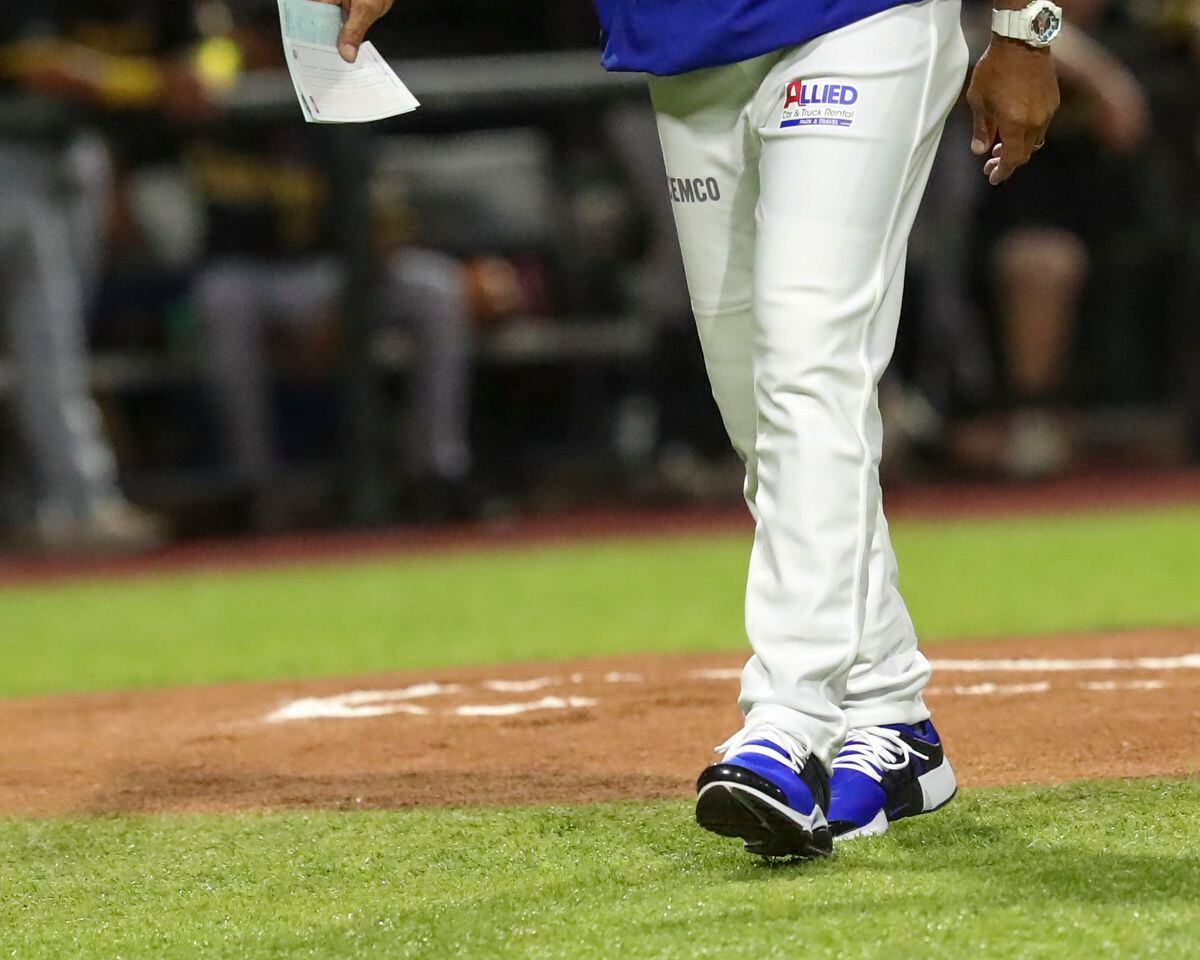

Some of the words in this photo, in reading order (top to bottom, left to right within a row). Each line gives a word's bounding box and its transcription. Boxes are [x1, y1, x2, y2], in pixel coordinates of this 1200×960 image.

[783, 80, 858, 109] ALLIED
[801, 108, 822, 117] Truck
[824, 108, 855, 118] Rental
[668, 176, 721, 203] EMCO
